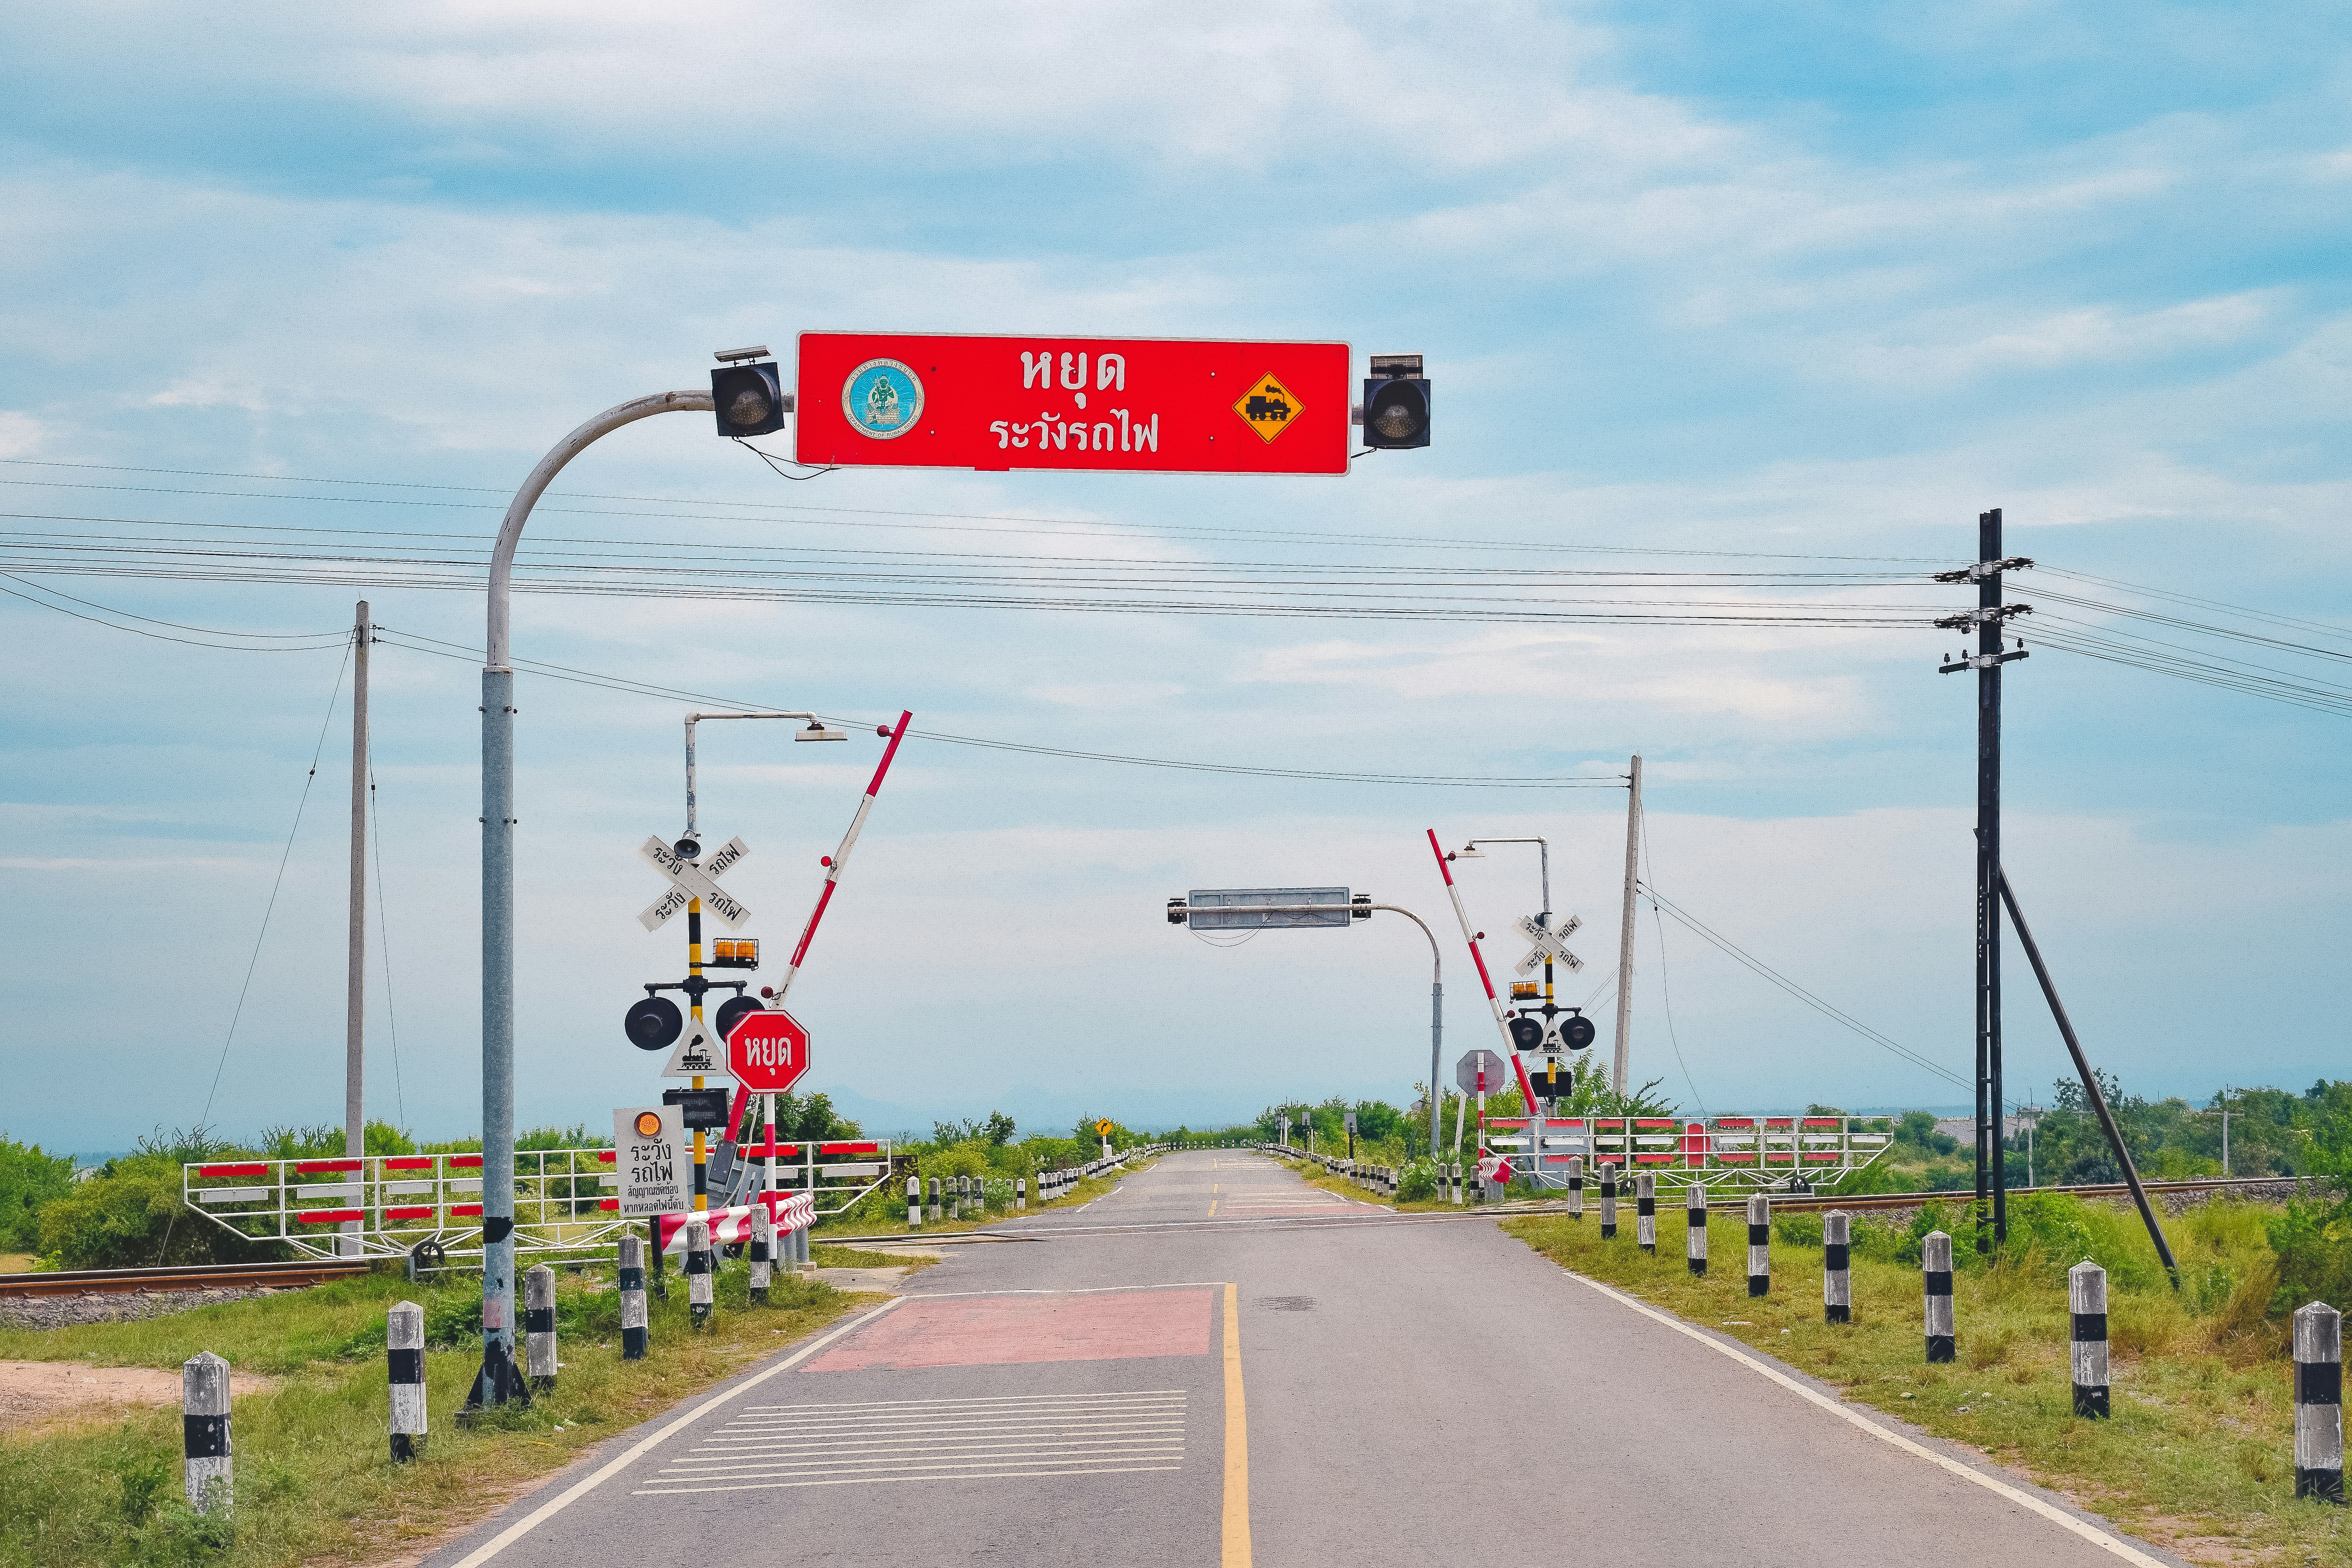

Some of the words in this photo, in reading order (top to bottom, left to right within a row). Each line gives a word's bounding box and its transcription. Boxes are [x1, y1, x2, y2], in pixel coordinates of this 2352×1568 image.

[850, 360, 916, 382] กรมทางหลวงชนบท
[1020, 351, 1125, 409] หยุด
[848, 414, 876, 437] DEPARTMENT
[887, 429, 904, 437] RURAL
[904, 415, 918, 430] ROADS
[990, 409, 1158, 452] ระวังรถไฟ
[653, 847, 683, 875] ระวัง
[709, 892, 742, 921] รถไฟ
[655, 891, 686, 920] ระวัง
[709, 843, 740, 875] รถไฟ
[1526, 923, 1544, 940] ระวัง
[1559, 951, 1579, 969] รถไฟ
[1527, 950, 1546, 969] ระวัง
[1559, 919, 1577, 939] รถไฟ
[745, 1037, 791, 1076] หยุด
[630, 1138, 671, 1161] ระวัง
[628, 1181, 679, 1198] สัญญาณขัดข้อง
[631, 1161, 673, 1183] รถไฟ
[623, 1195, 684, 1213] หากหลอดไฟนี้ดับ
